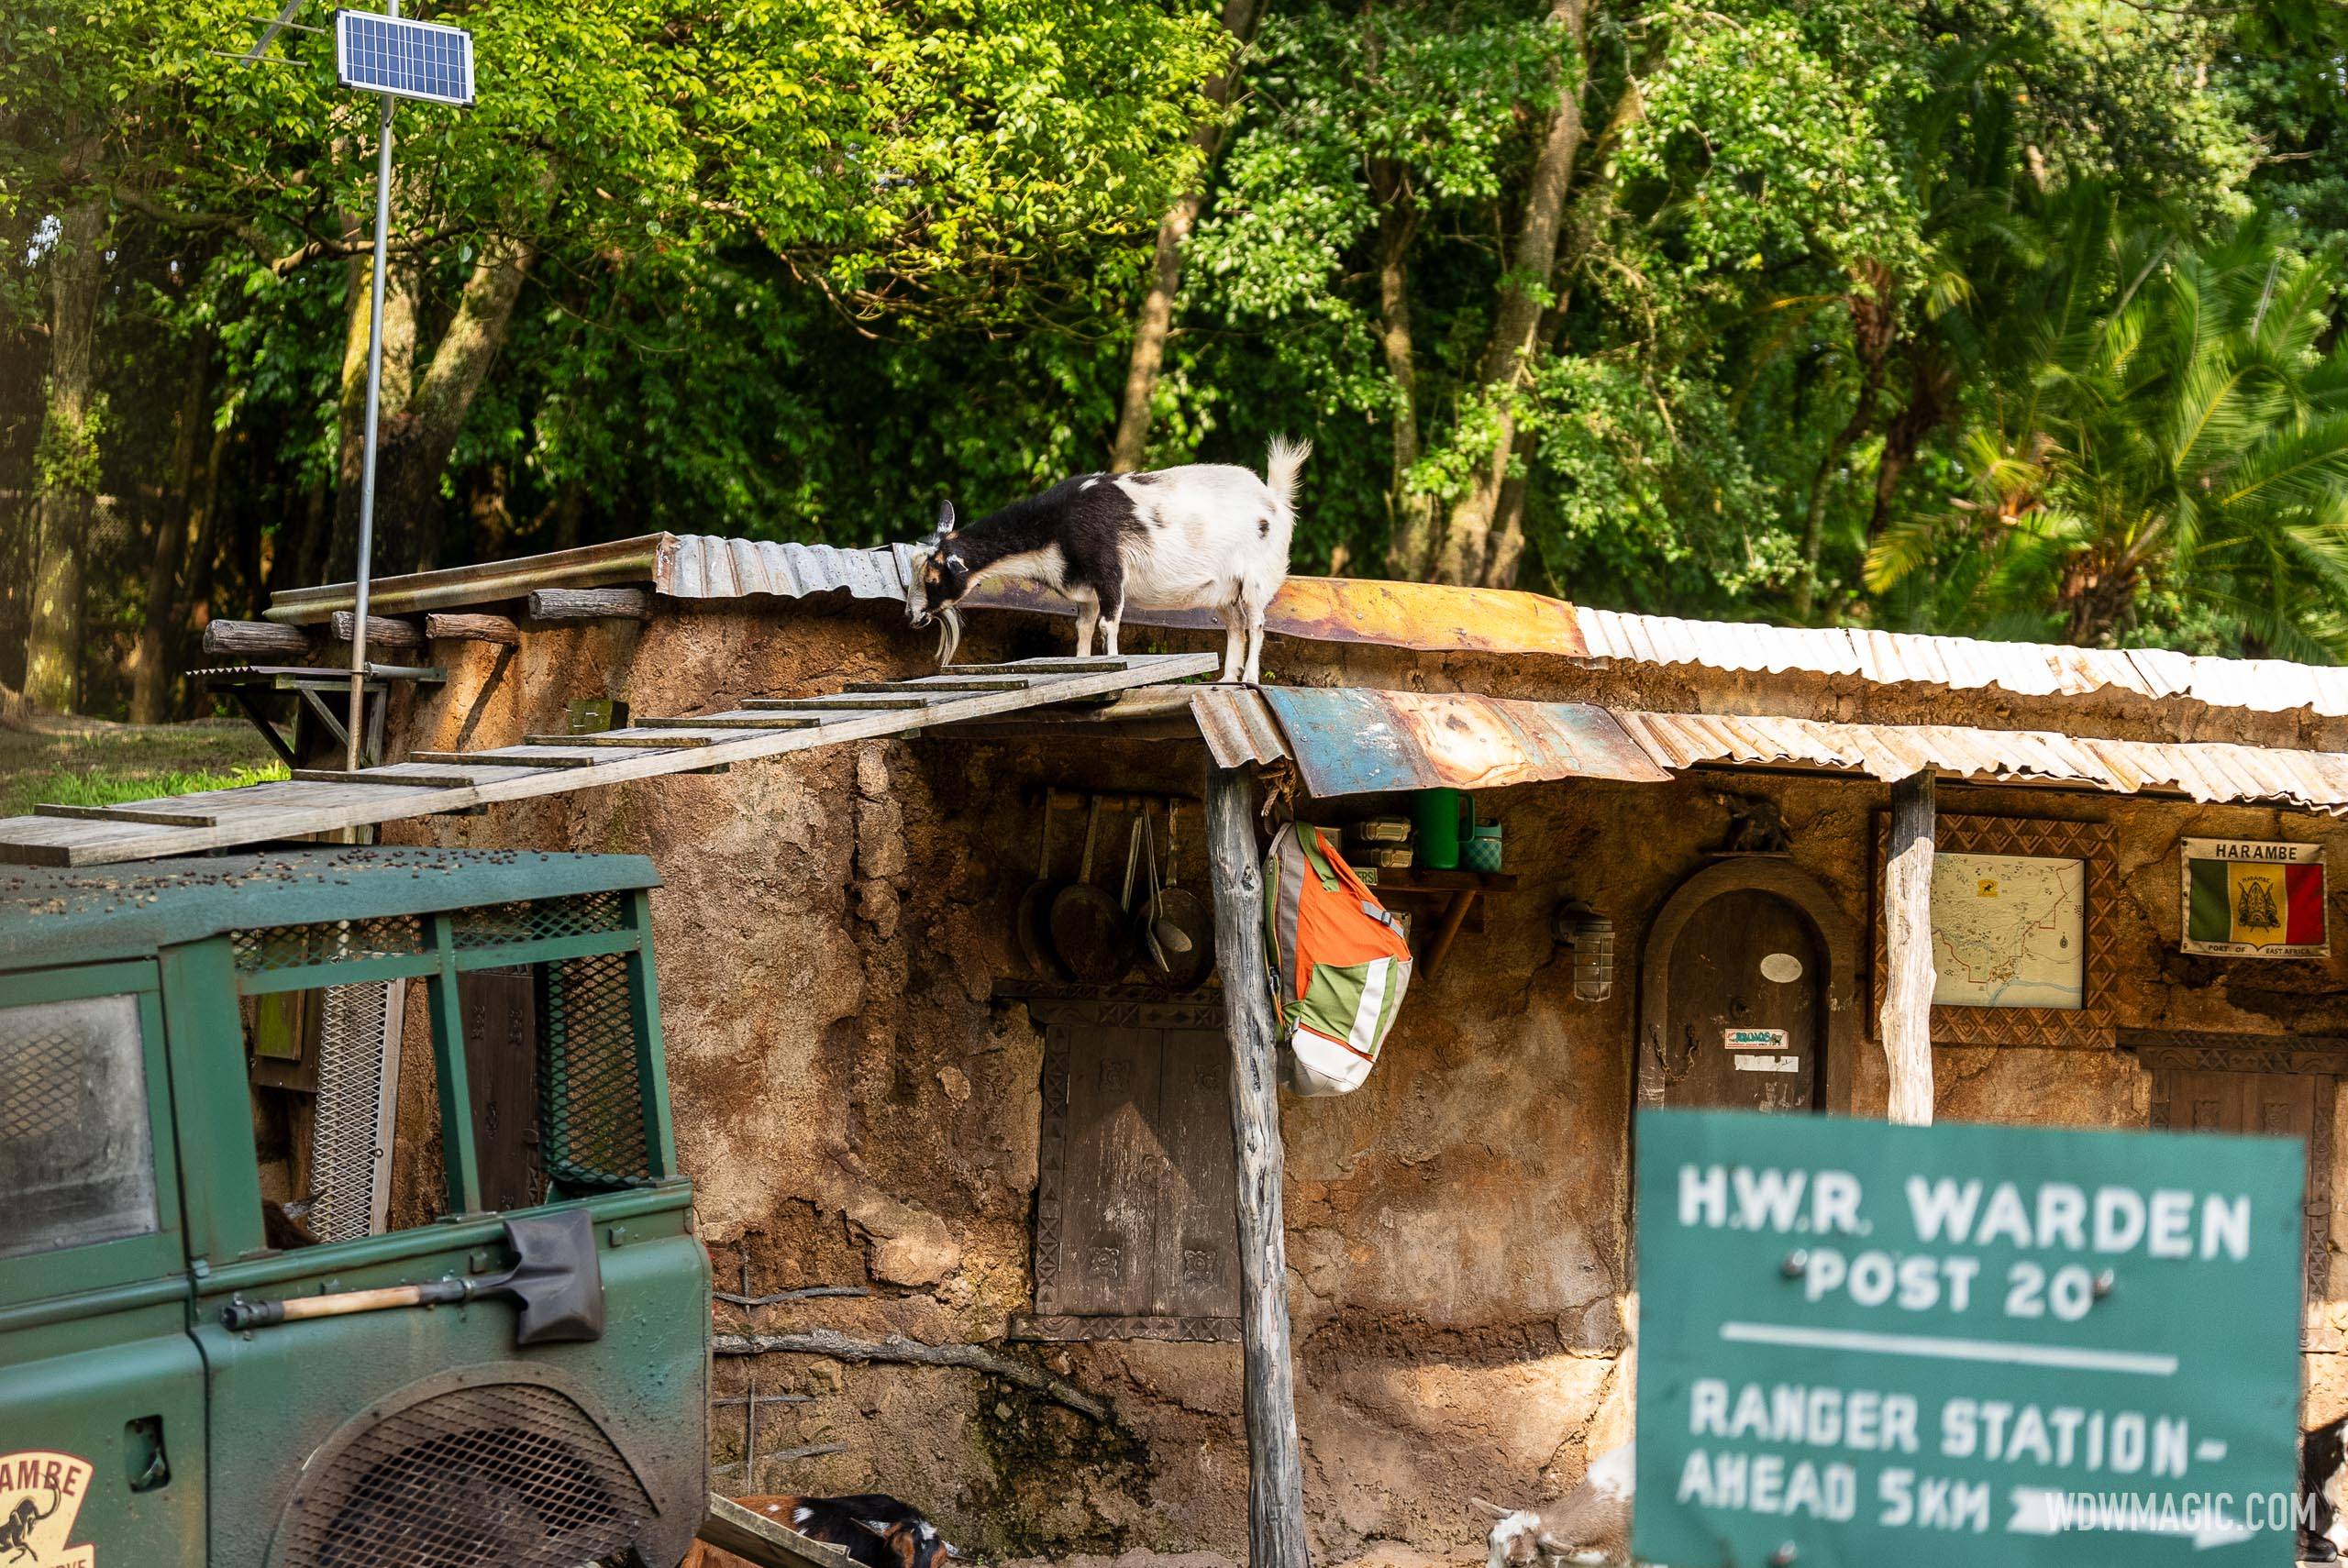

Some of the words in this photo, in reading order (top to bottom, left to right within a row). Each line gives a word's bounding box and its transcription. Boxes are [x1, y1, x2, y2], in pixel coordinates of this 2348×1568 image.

[2216, 844, 2298, 860] HARAMBE
[1678, 1164, 1874, 1236] H.W.R.
[1904, 1175, 2252, 1261] WARDEN
[1804, 1247, 1981, 1312] POST
[2004, 1261, 2094, 1321] 20
[1689, 1377, 1920, 1453] RANGER
[1676, 1448, 1856, 1522] AHEAD
[1877, 1467, 1991, 1534] 5KM
